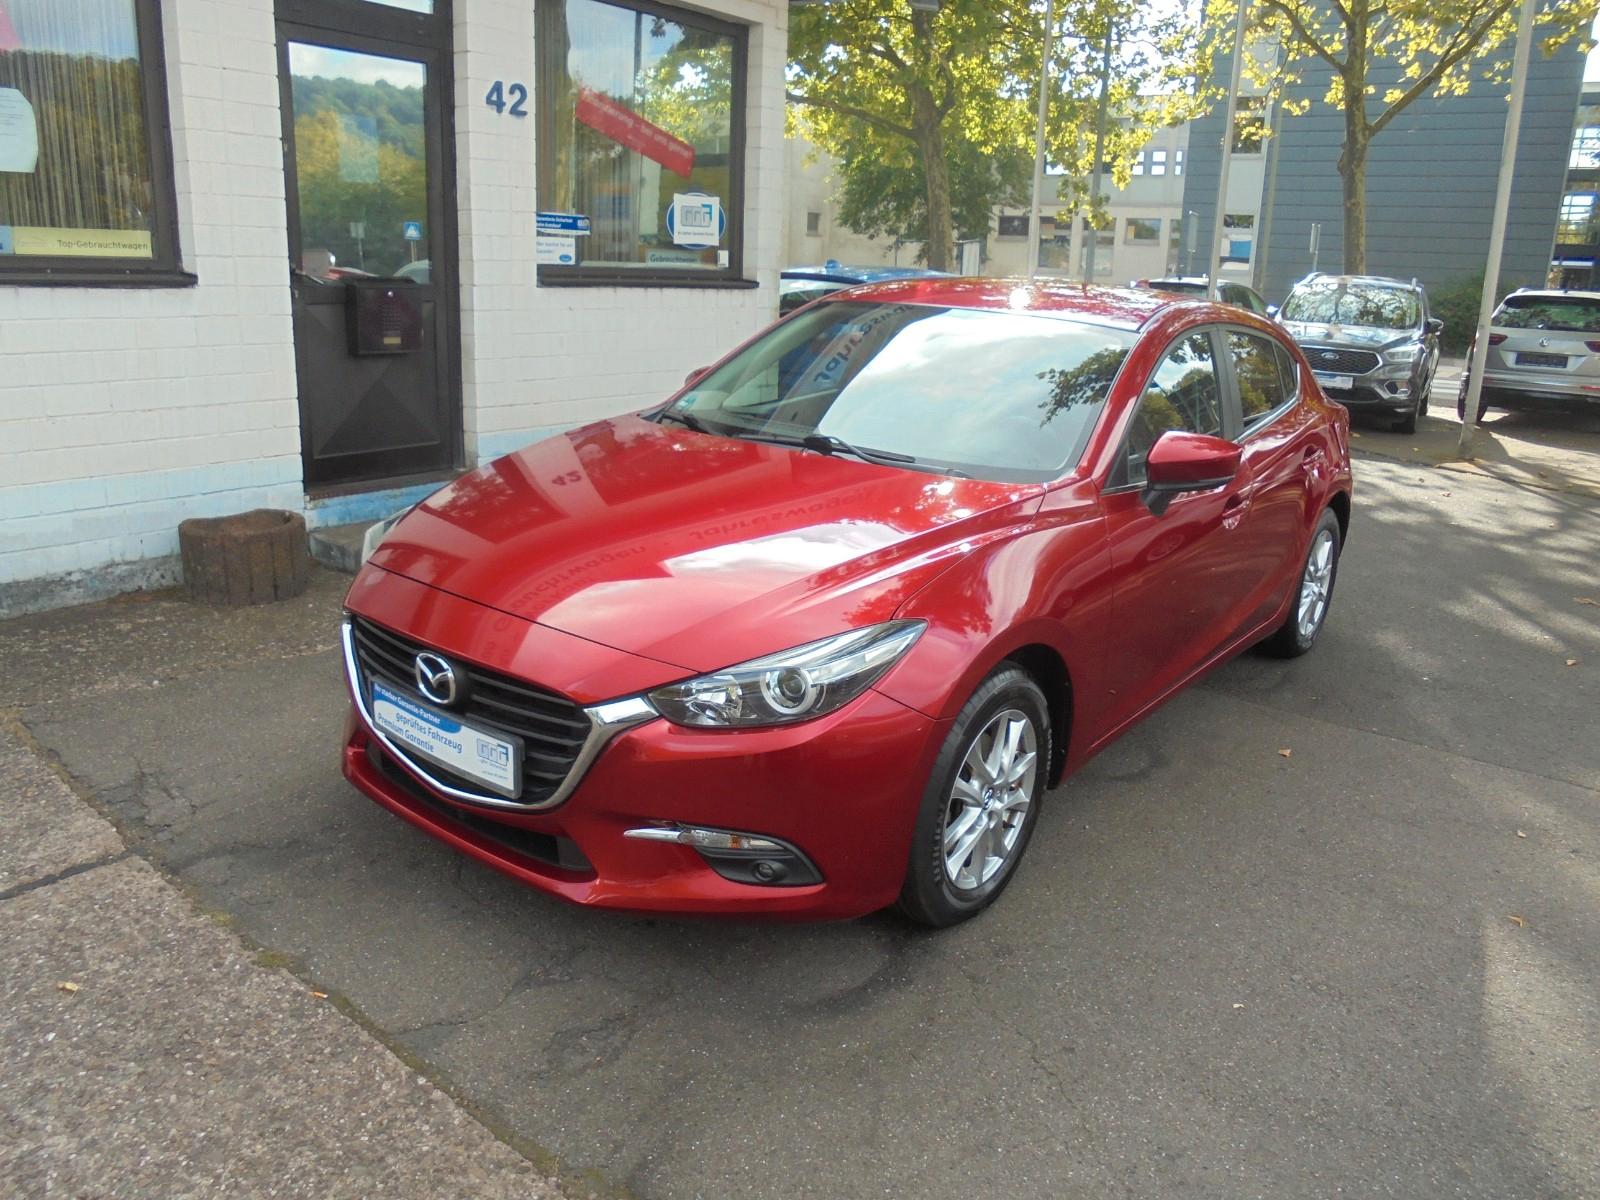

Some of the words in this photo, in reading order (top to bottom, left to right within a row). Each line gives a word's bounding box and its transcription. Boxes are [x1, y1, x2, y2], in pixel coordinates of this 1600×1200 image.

[485, 80, 528, 117] 42
[57, 239, 149, 251] Top-Gebrauchtwagen
[377, 712, 404, 737] Premium
[404, 729, 434, 753] Garantie
[396, 711, 427, 735] geprüftes
[427, 727, 463, 754] Fahrzeug
